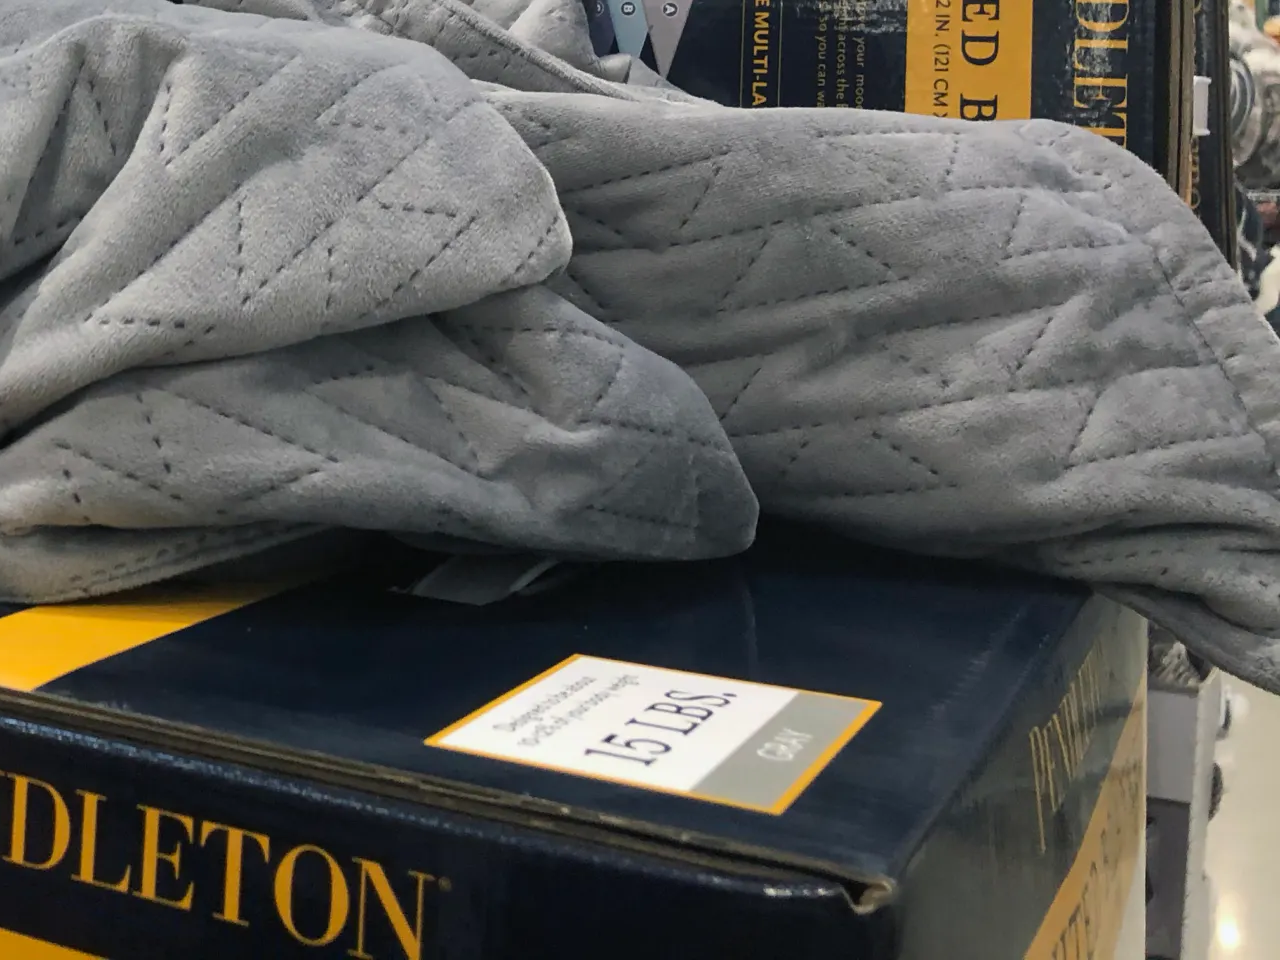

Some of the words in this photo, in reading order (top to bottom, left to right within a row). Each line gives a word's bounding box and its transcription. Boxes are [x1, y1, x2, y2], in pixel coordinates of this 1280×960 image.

[819, 14, 829, 31] so
[934, 14, 950, 37] IN.
[751, 10, 770, 107] MULTI-LA
[815, 35, 827, 60] you
[836, 34, 847, 74] across
[853, 36, 866, 68] your
[933, 44, 951, 72] (121
[817, 64, 826, 87] can
[836, 77, 850, 100] the
[932, 78, 949, 107] CM
[625, 690, 738, 736] LBS.
[585, 734, 672, 767] 15
